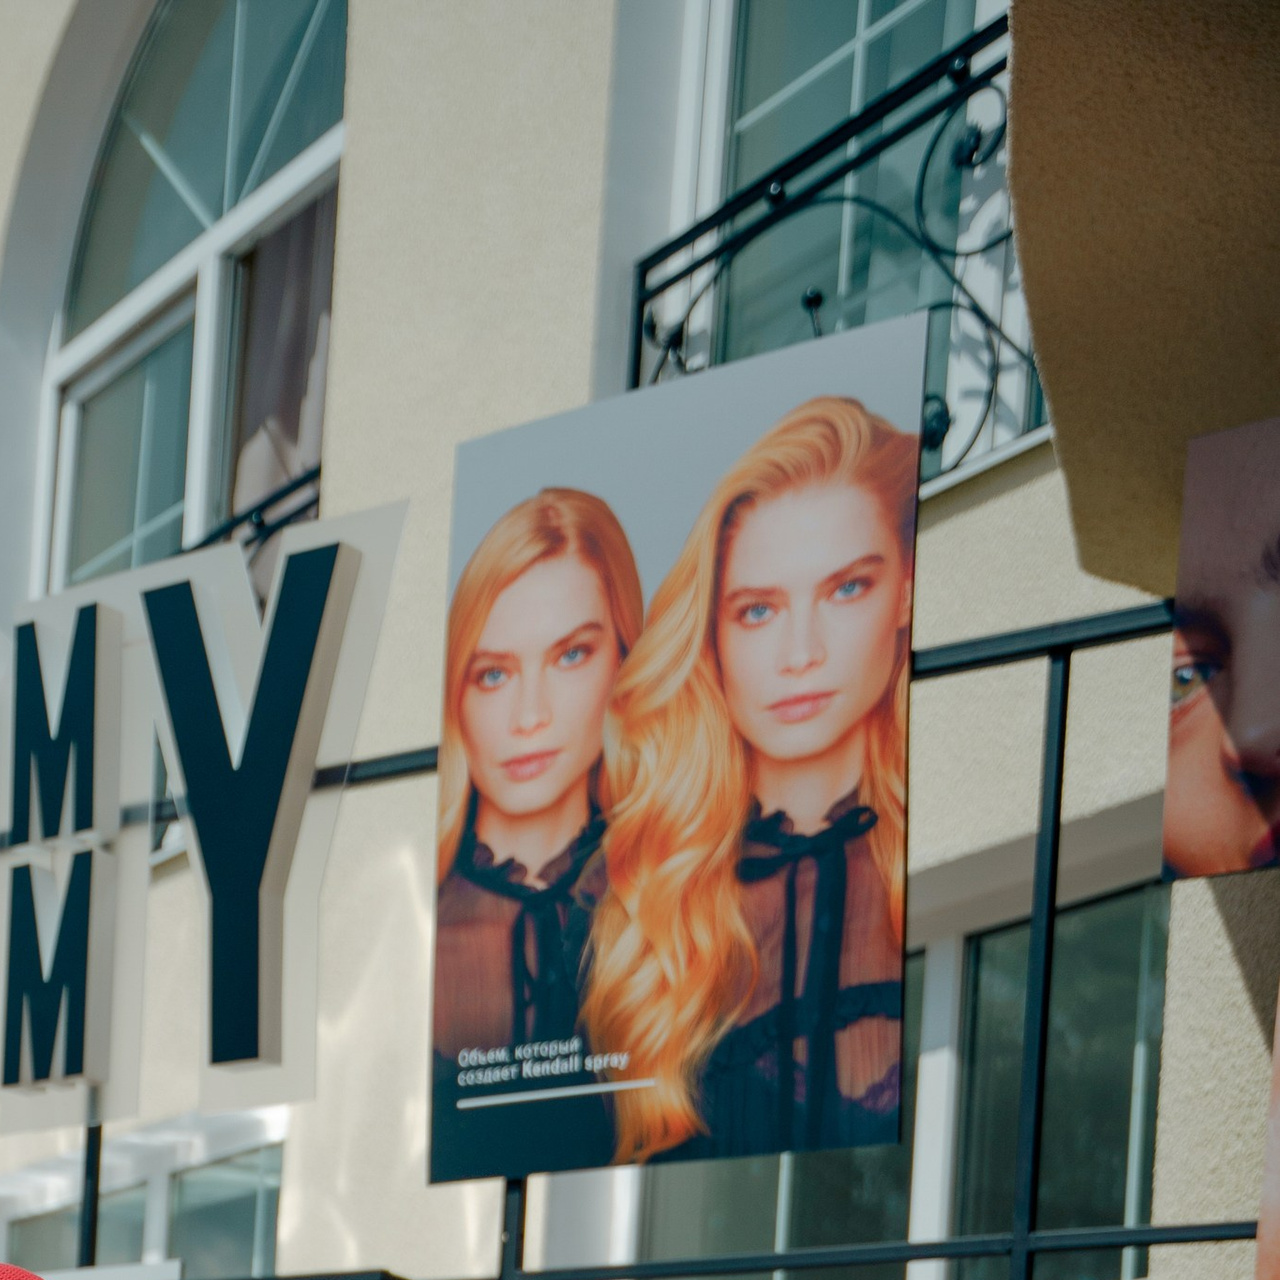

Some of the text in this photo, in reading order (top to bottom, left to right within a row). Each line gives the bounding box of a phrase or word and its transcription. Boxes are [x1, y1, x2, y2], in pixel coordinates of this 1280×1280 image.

[515, 1036, 582, 1060] который
[457, 1052, 630, 1086] создает Kendall spray
